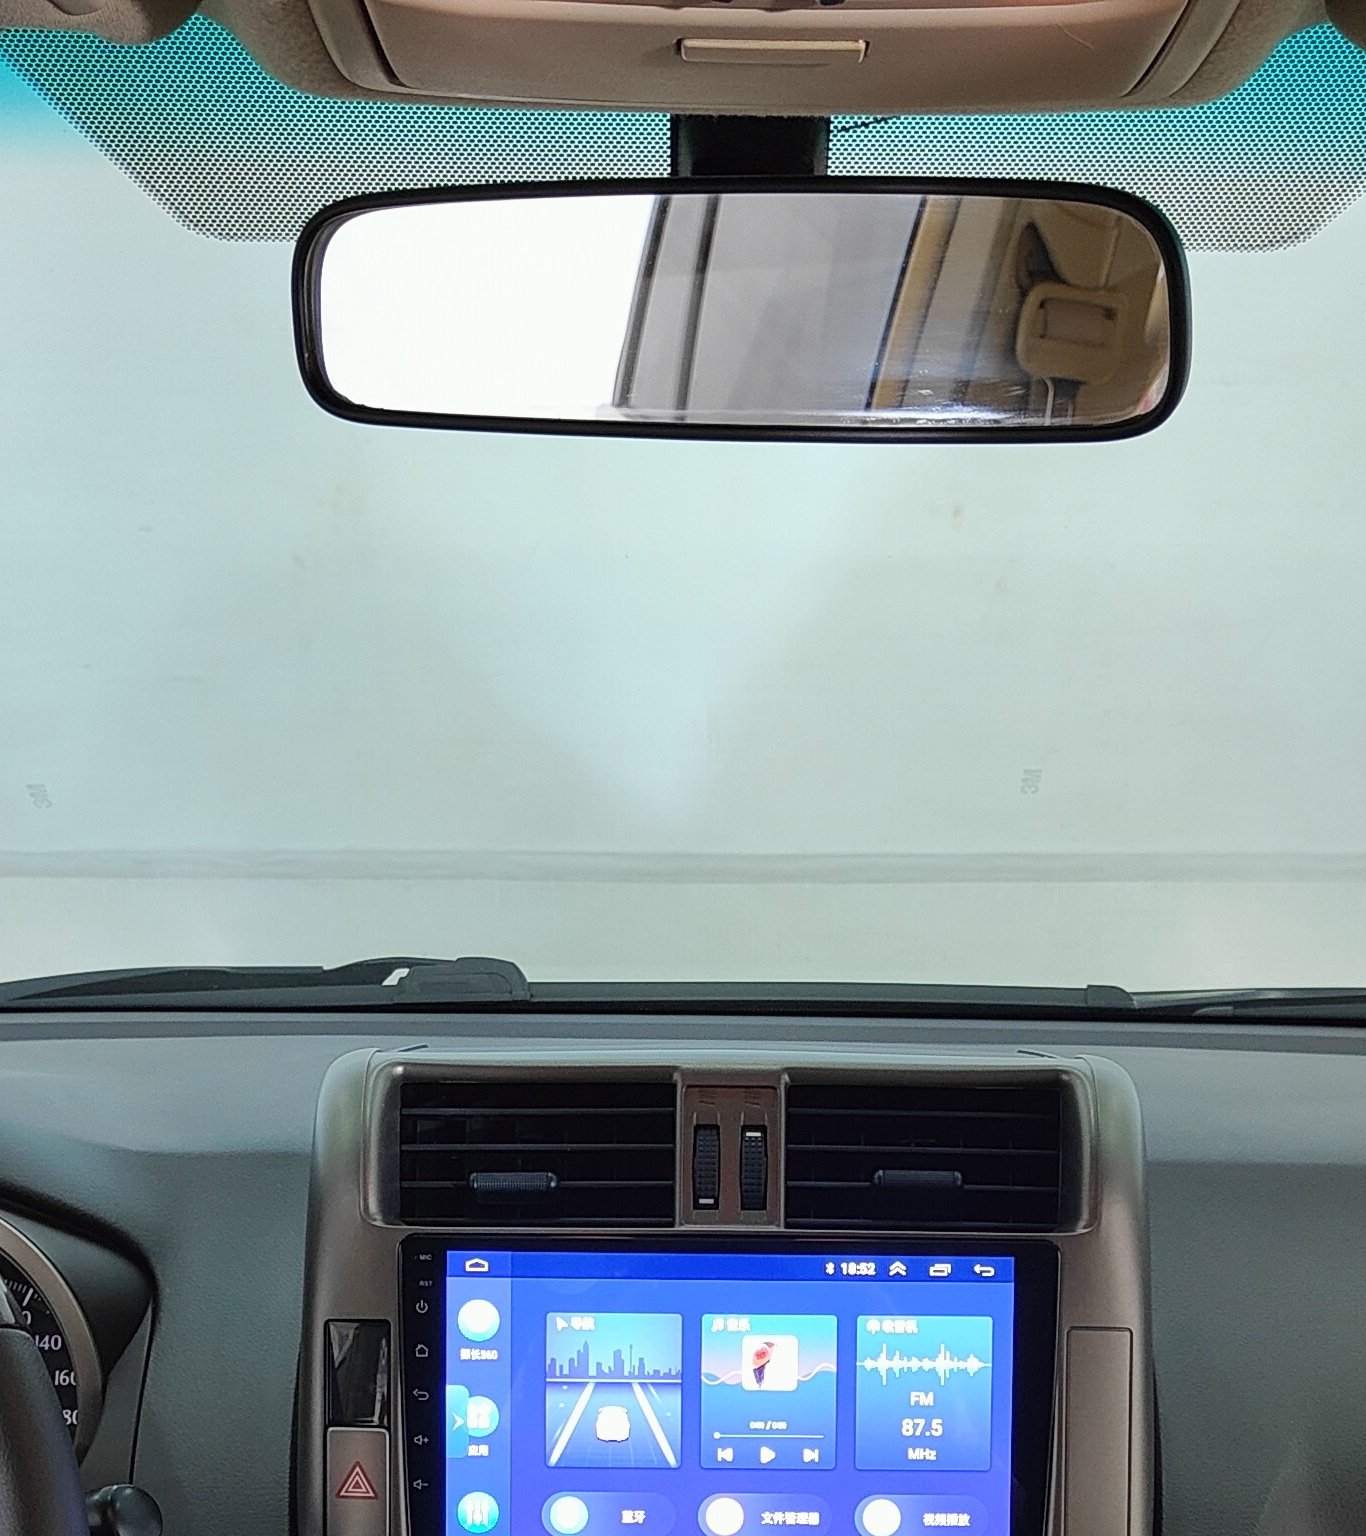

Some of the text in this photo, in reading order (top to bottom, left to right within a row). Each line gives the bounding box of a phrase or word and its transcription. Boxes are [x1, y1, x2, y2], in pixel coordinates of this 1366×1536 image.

[910, 1391, 934, 1406] FM
[901, 1418, 943, 1437] 87.5
[907, 1448, 937, 1461] MHz
